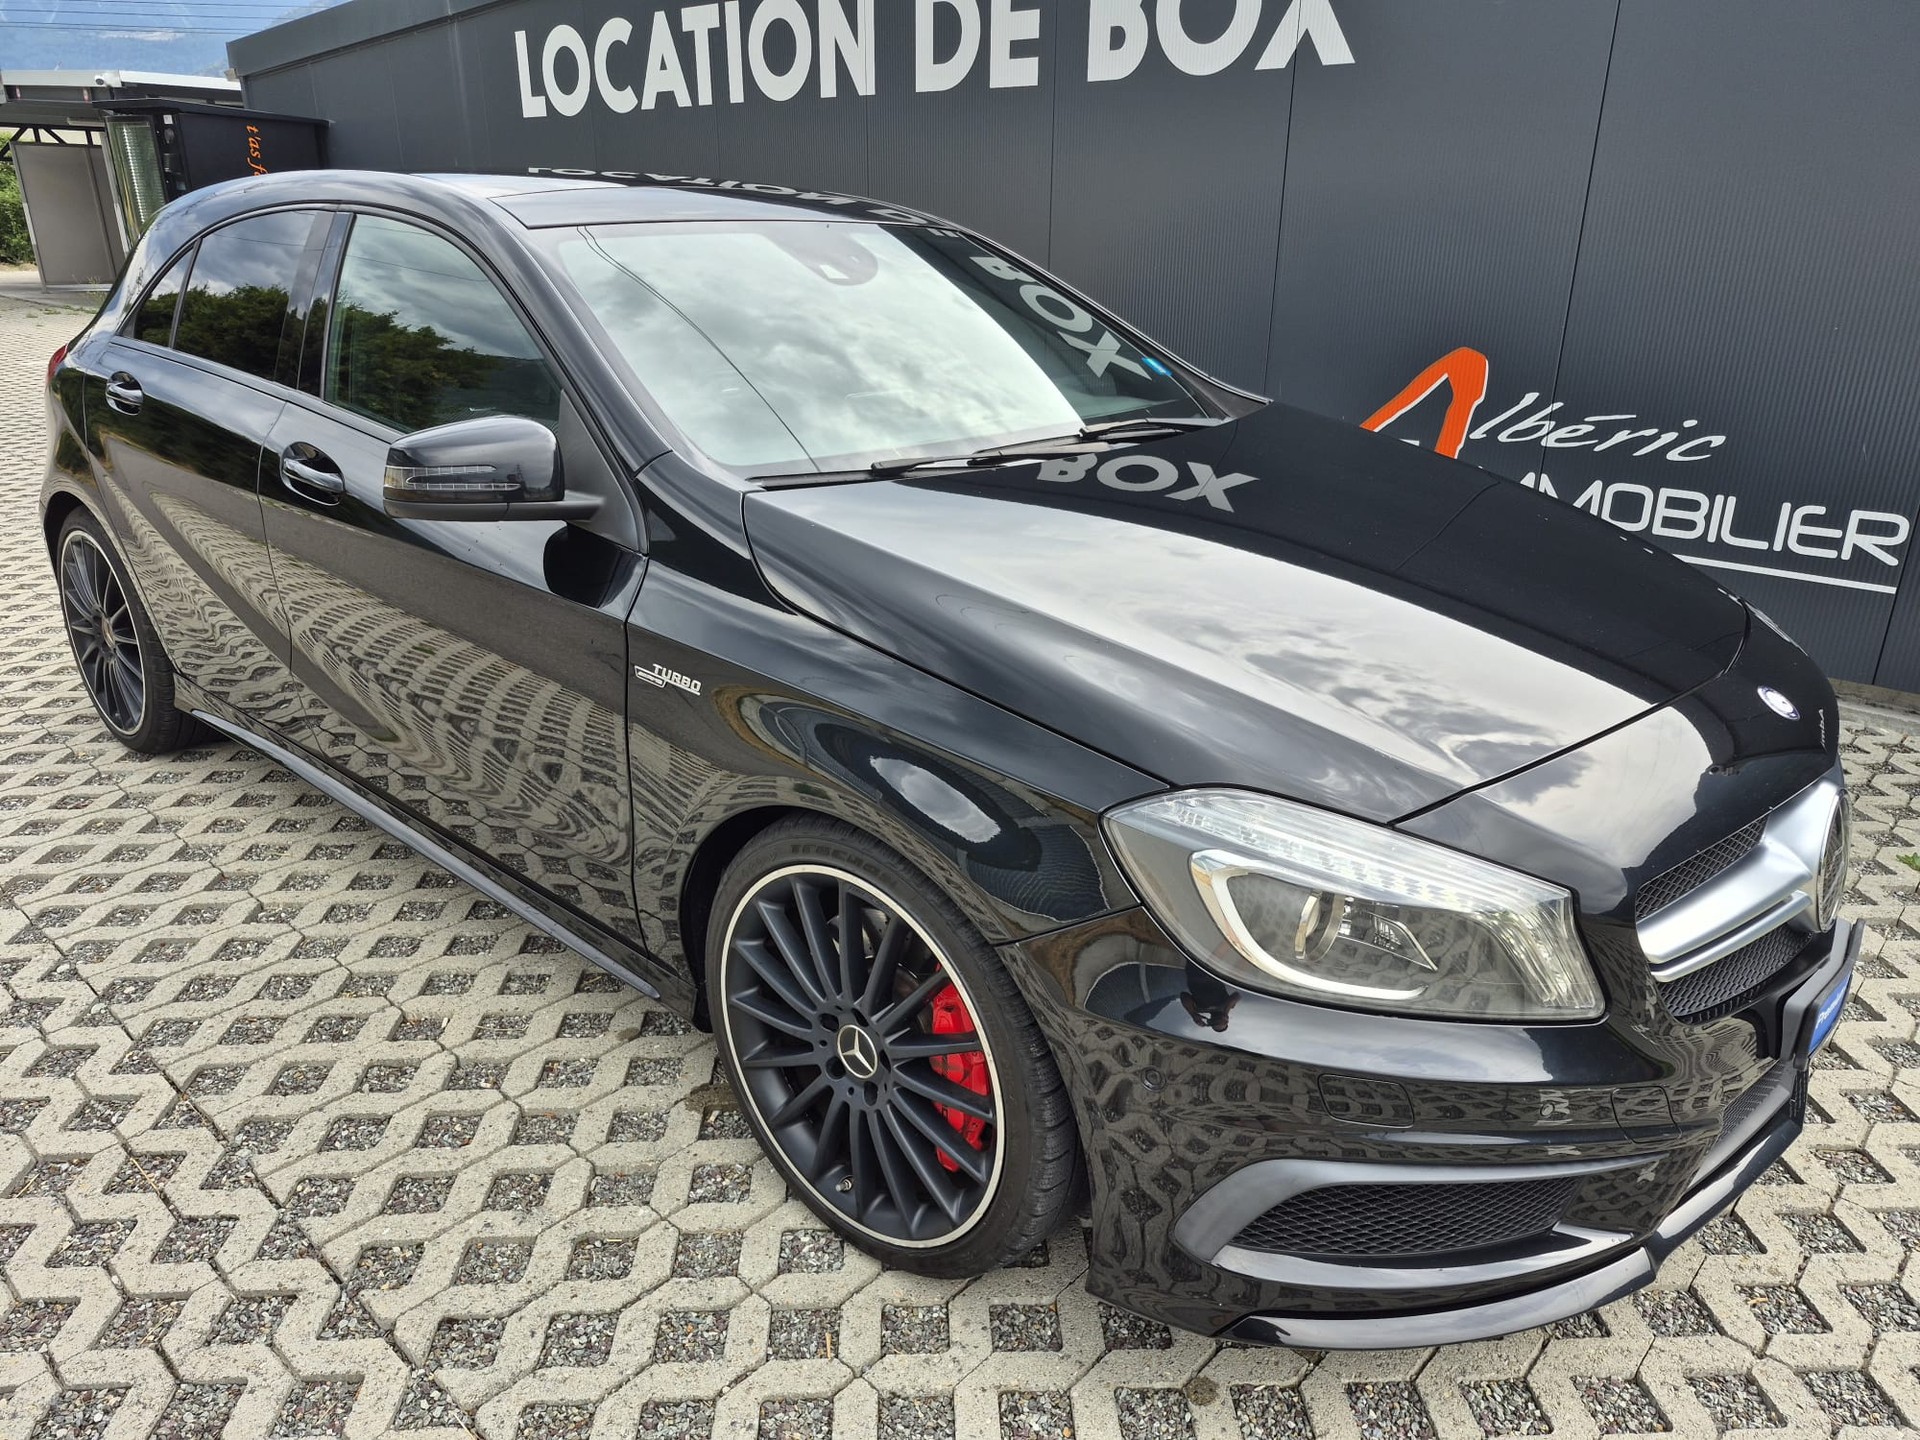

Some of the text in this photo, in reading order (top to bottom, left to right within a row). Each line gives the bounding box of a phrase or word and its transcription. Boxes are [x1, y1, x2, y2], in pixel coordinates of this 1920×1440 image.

[514, 0, 876, 118] LOCATION
[915, 0, 1040, 93] DE
[1518, 471, 1910, 567] MOBILIER
[652, 663, 702, 692] TURBO
